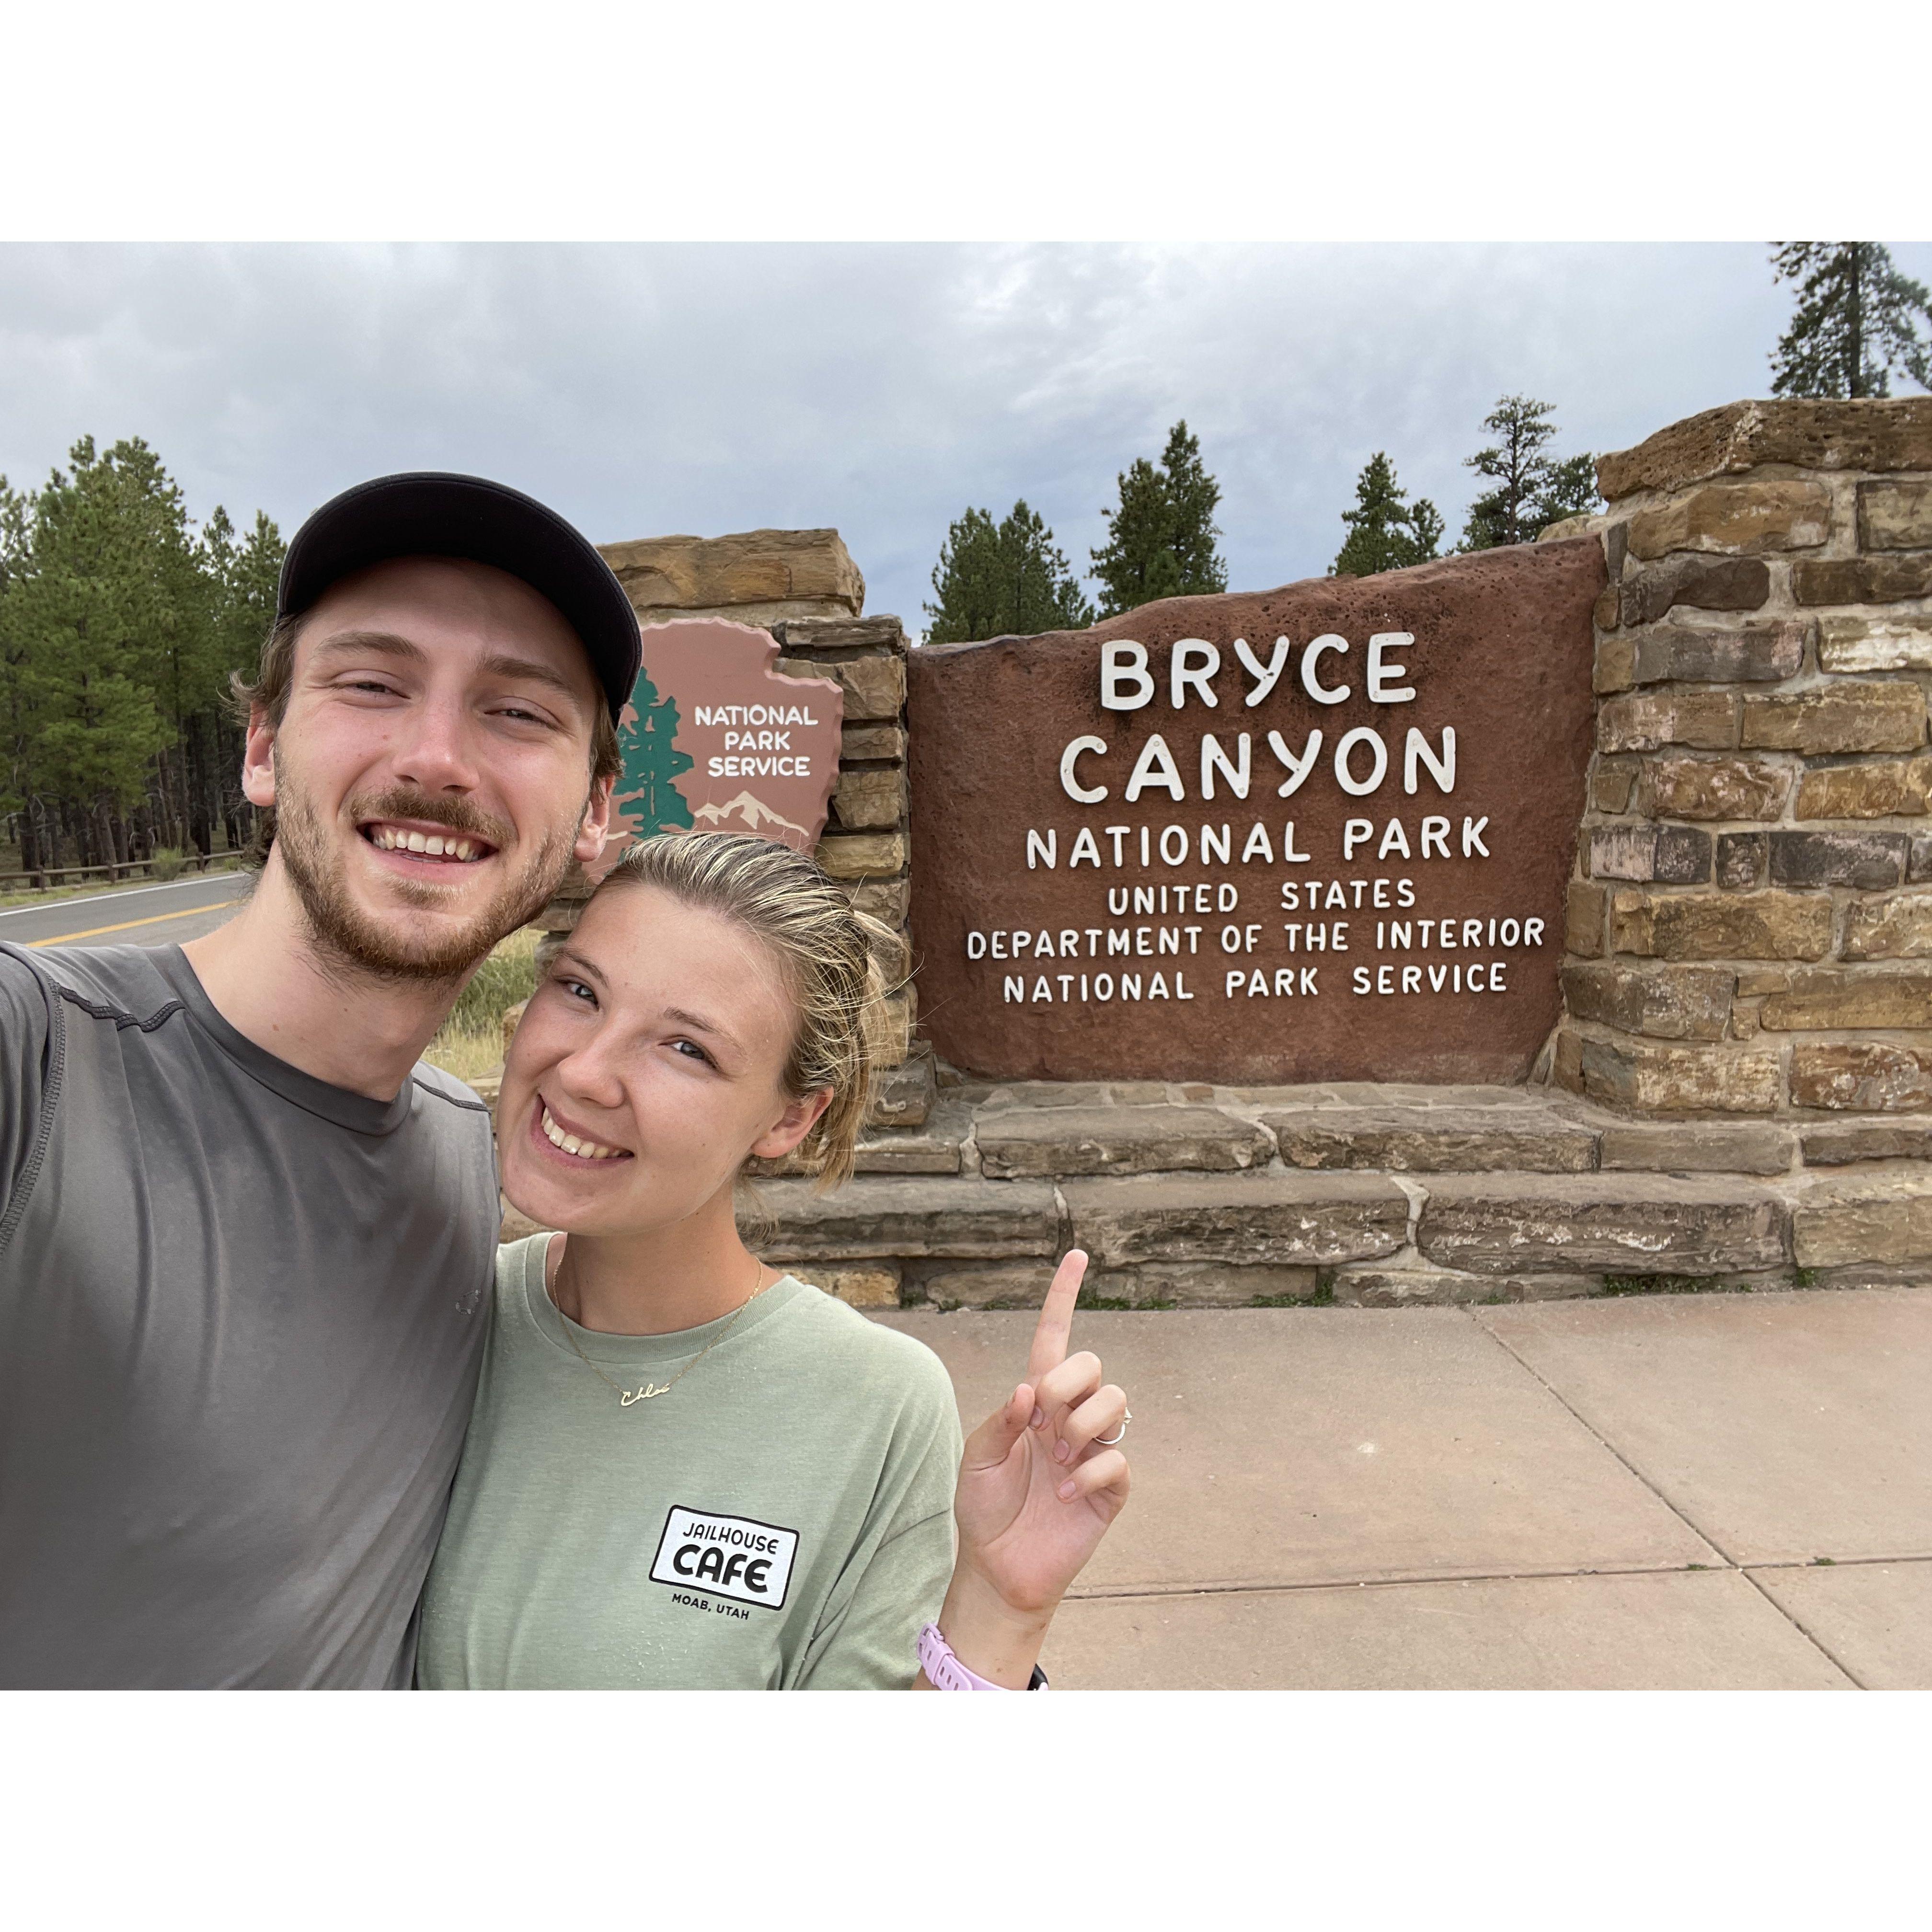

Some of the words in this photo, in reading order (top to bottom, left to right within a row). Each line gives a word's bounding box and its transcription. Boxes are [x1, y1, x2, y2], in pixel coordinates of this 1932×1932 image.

[1101, 631, 1416, 711] BRYCE
[694, 703, 819, 726] NATIONAL
[724, 730, 791, 751] PARK
[708, 756, 811, 778] SERVICE
[1059, 725, 1456, 804] CANYON
[1026, 820, 1311, 870] NATIONAL
[1344, 815, 1490, 861] PARK
[1108, 883, 1239, 916] UNITED
[1280, 878, 1416, 910] STATES
[967, 926, 1203, 960] DEPARTMENT
[1221, 923, 1263, 954] OF
[1284, 921, 1349, 953] THE
[1377, 917, 1545, 950] INTERIOR
[1004, 971, 1195, 1003] NATIONAL
[1225, 966, 1319, 999] PARK
[1352, 962, 1507, 995] SERVICE
[683, 1523, 780, 1554] JAILHOUSE
[673, 1544, 773, 1593] CAFE
[672, 1593, 711, 1612] MOAB,
[716, 1604, 750, 1620] UTAH
